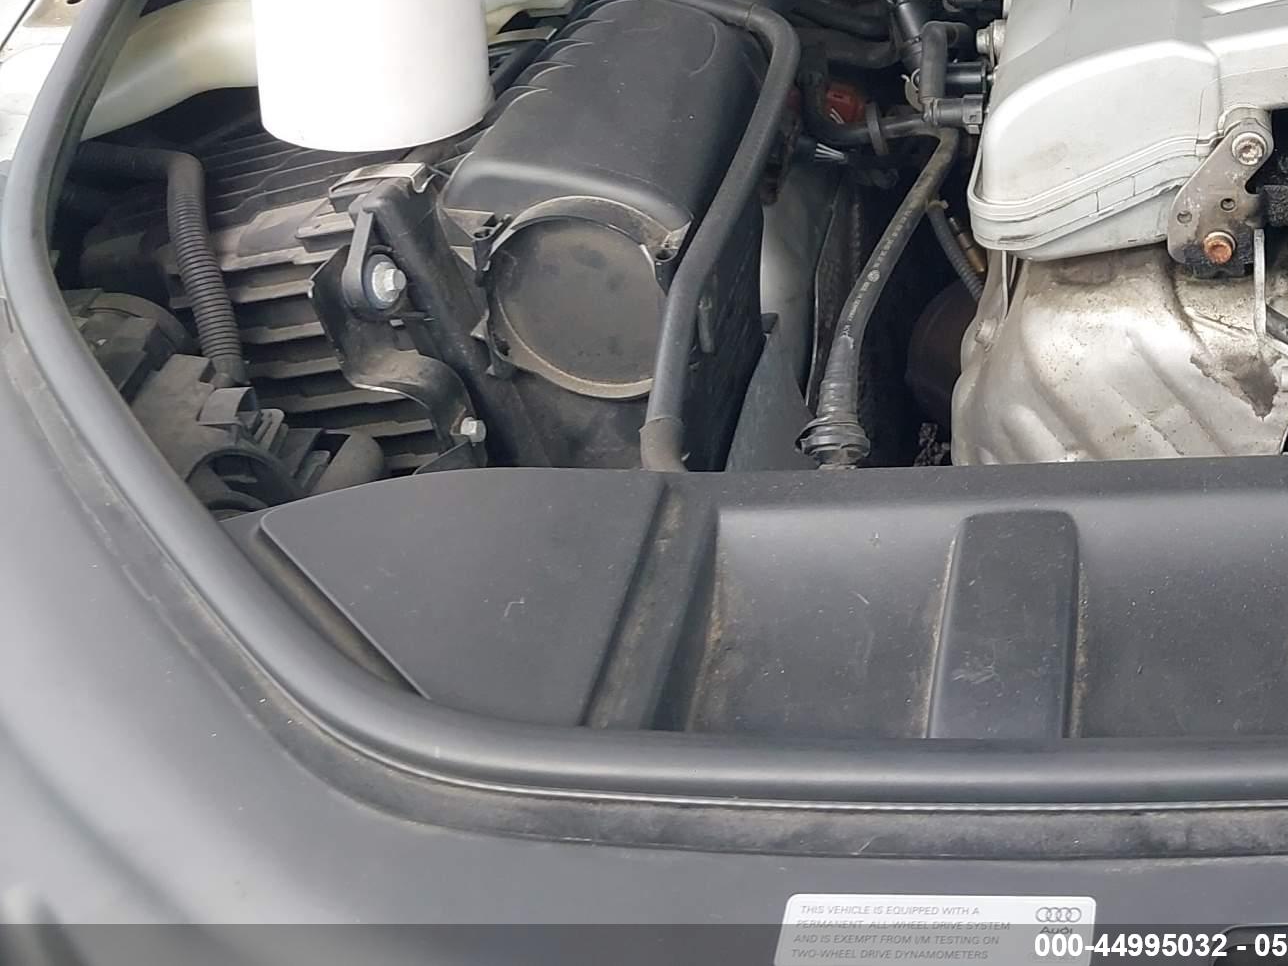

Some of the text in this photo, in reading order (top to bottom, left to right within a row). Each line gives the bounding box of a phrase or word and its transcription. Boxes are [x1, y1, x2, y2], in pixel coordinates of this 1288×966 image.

[801, 905, 980, 916] THIS VEHICLE IS EQUIPPED WITH A
[796, 920, 1011, 930] PERMANENT ALL-WHEEL DRIVE SYSTEM
[1039, 926, 1074, 935] Audi
[793, 934, 1001, 945] AND IS EXEMPT FROM I/M TESTING ON
[791, 949, 989, 960] TWO-WHEEL DRIVE DYNAMOMETERS
